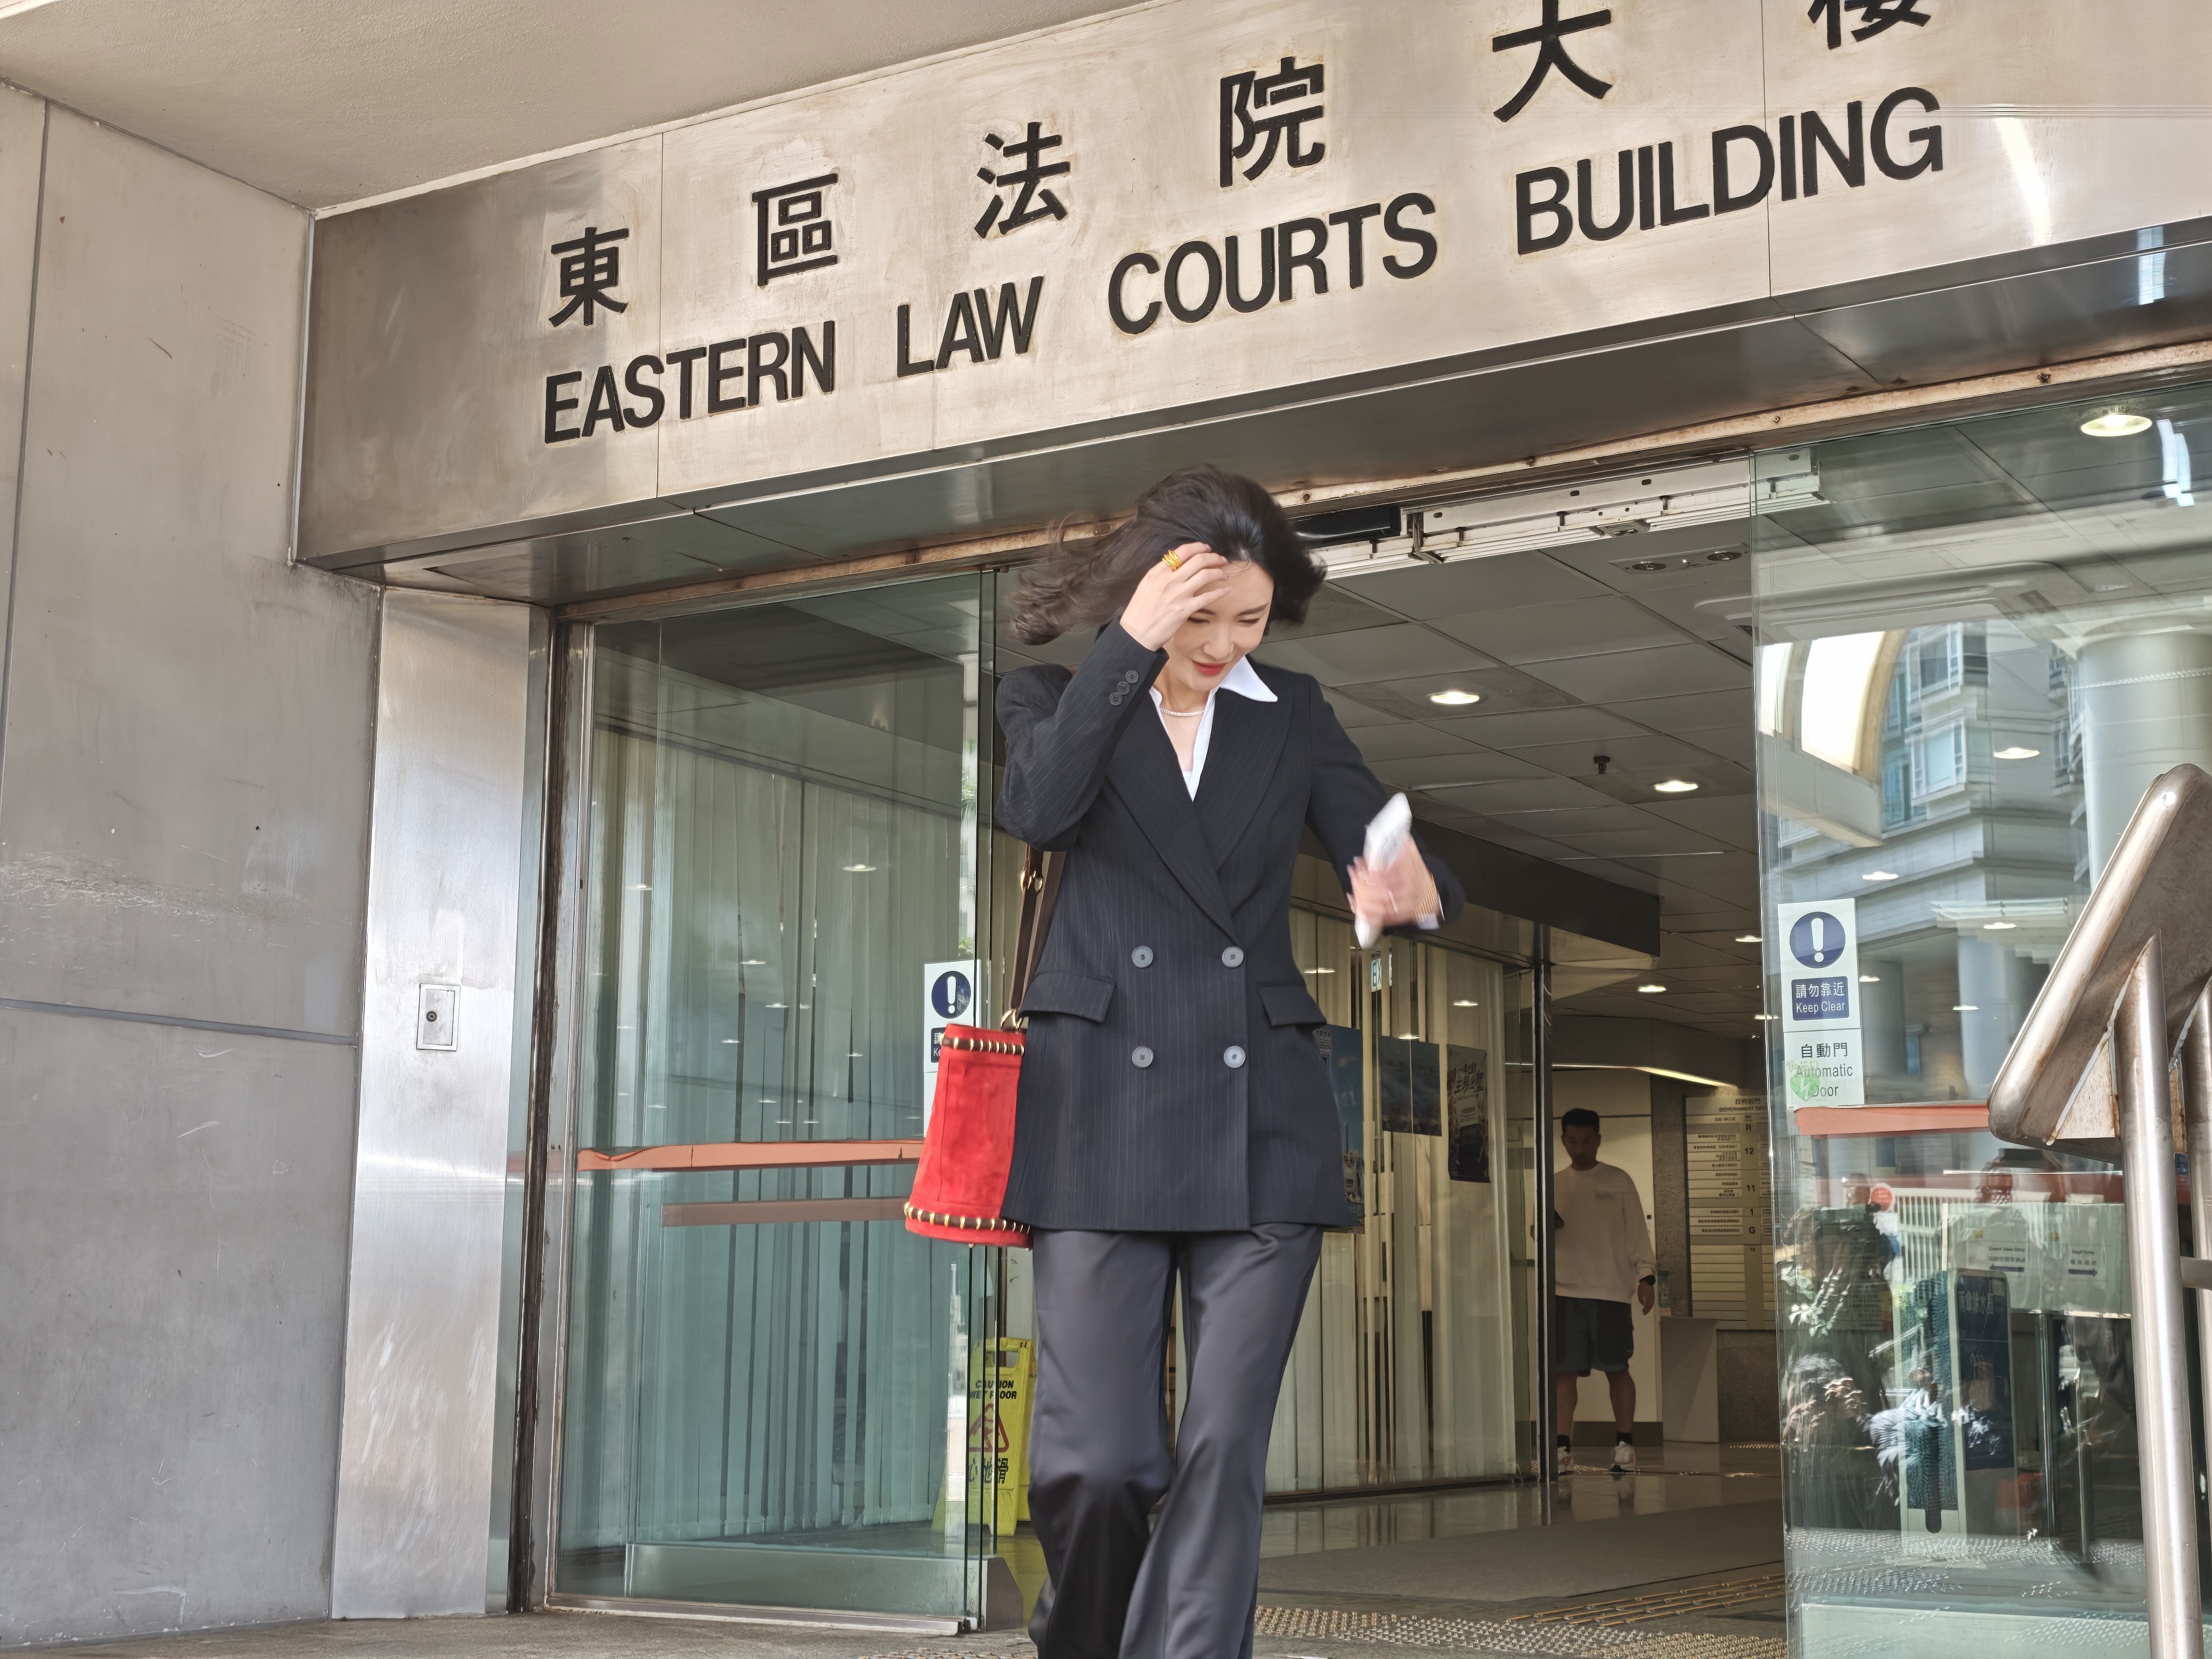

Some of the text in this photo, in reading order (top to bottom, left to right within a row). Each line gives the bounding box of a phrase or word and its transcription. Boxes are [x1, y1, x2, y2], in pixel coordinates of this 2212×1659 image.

[544, 86, 1944, 444] EASTERN LAW COURTS BUILDING
[1795, 982, 1845, 999] 請勿靠近
[1796, 1001, 1845, 1015] Keep Clear
[1801, 1042, 1848, 1058] 自動門
[1796, 1063, 1853, 1078] Automatic
[975, 1380, 1014, 1389] CUION
[989, 1390, 1017, 1400] FOOR
